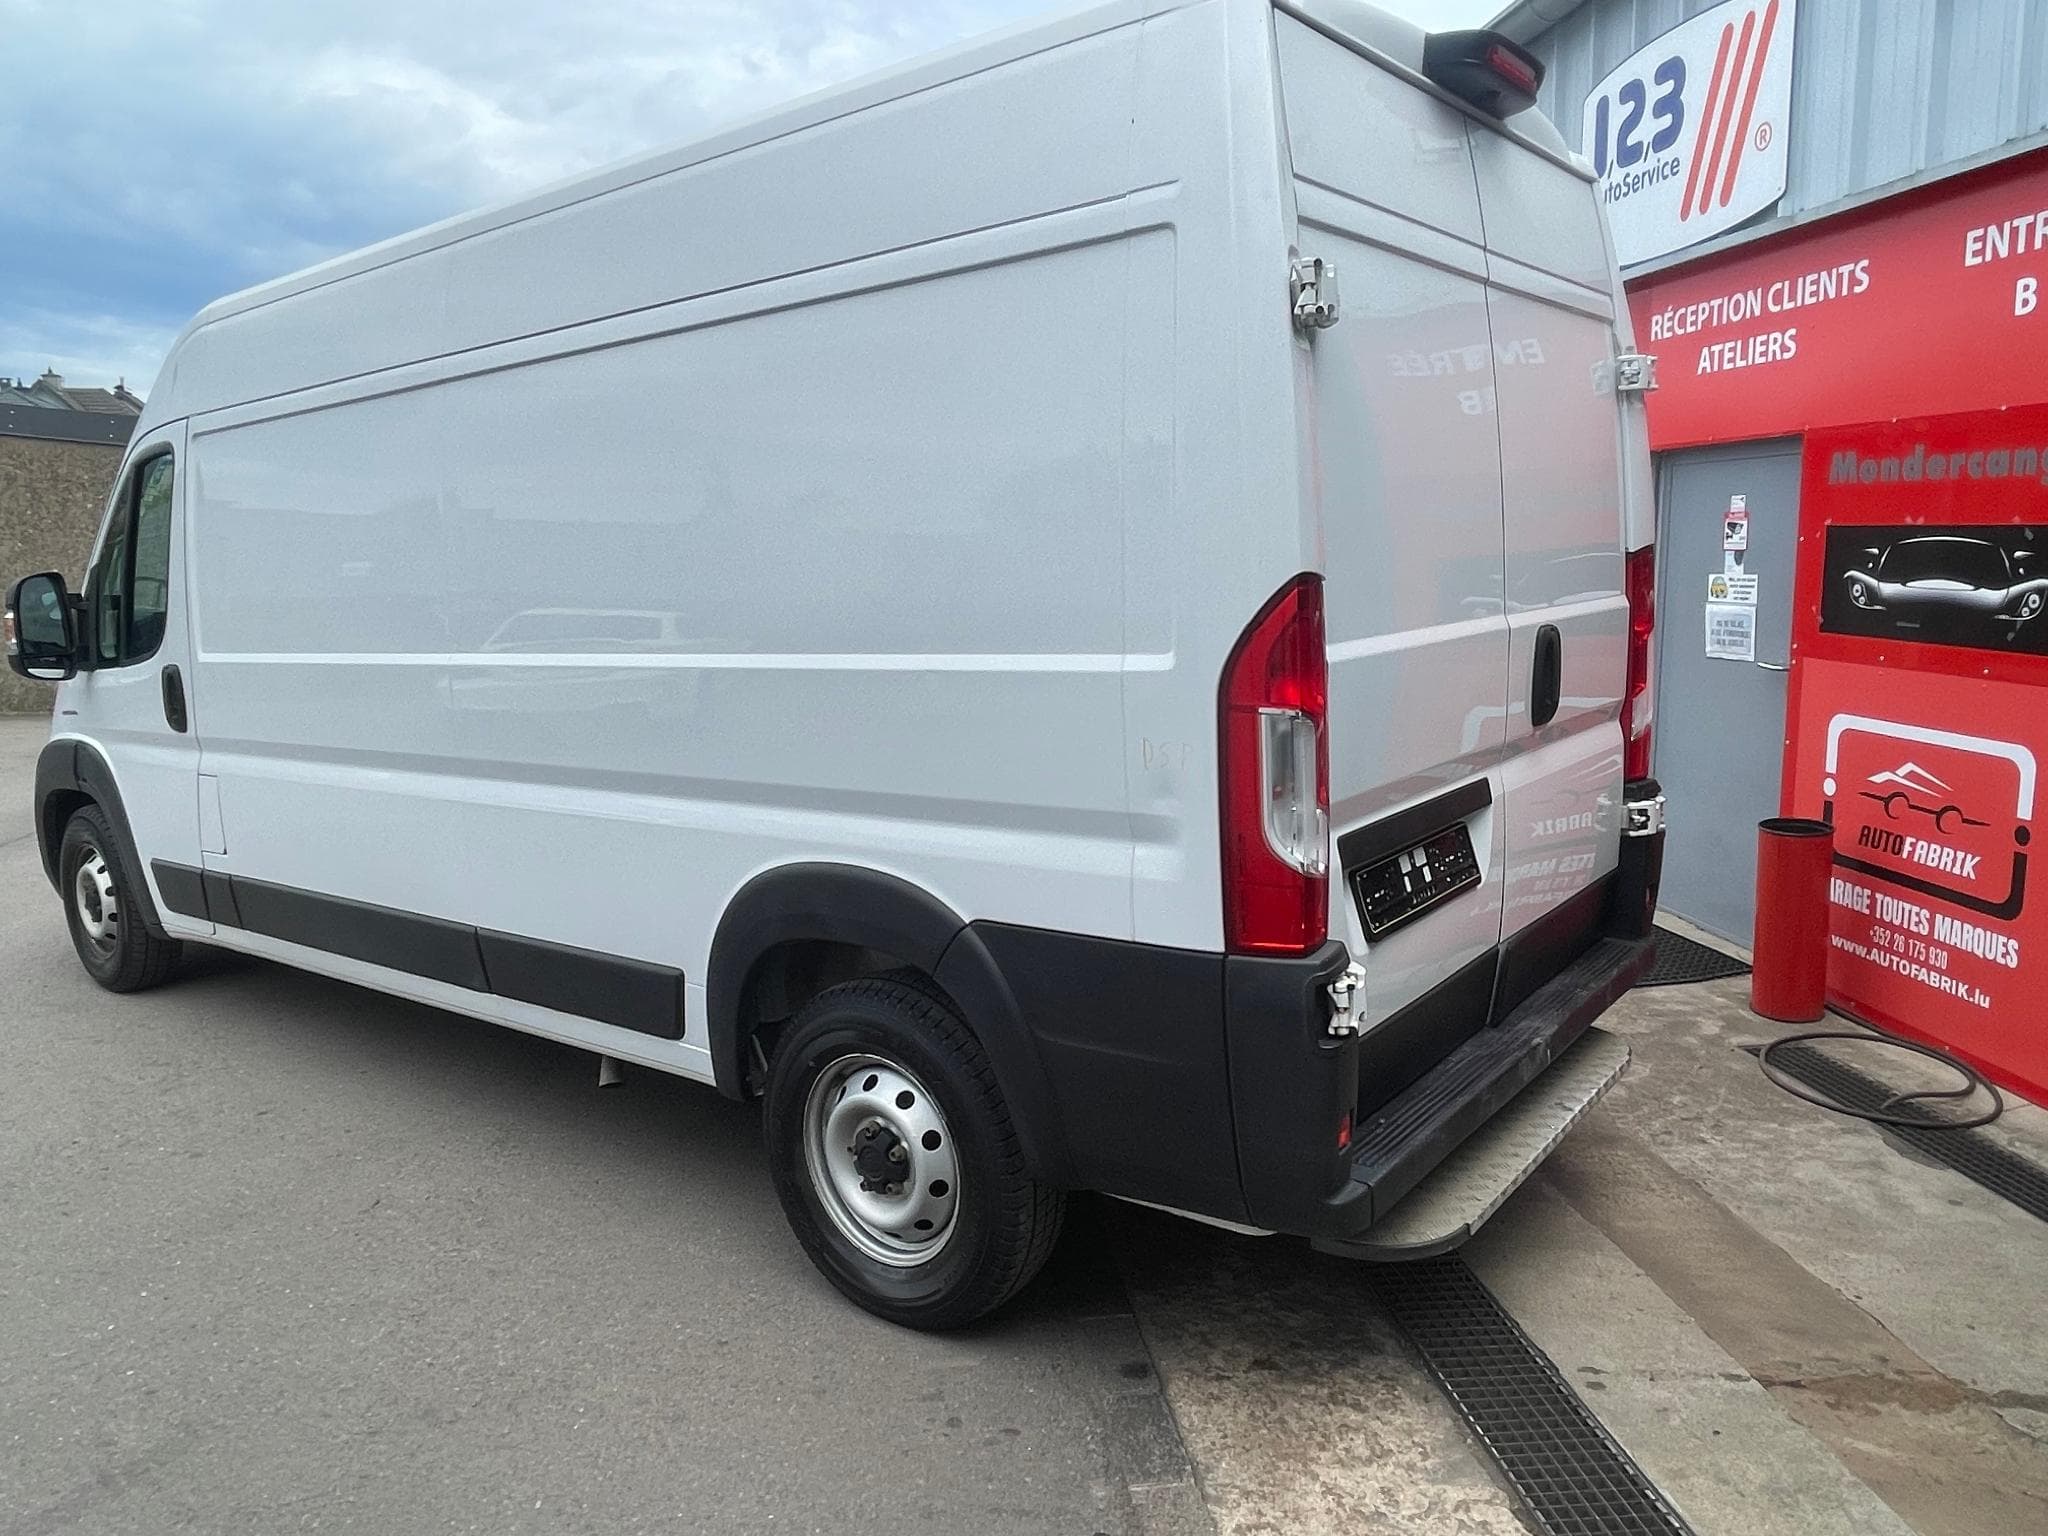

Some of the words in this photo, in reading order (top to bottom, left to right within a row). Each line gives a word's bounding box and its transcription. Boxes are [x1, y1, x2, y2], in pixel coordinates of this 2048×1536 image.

[1650, 287, 1763, 342] RÉCEPTION
[1766, 259, 1870, 313] CLIENTS
[2014, 277, 2038, 317] B
[1696, 328, 1797, 375] ATELIERS
[1875, 892, 1930, 936] TOUTES
[1934, 913, 2019, 969] MARQUES
[1893, 933, 1905, 953] 26
[1908, 939, 1926, 962] 175
[1929, 946, 1948, 970] 930
